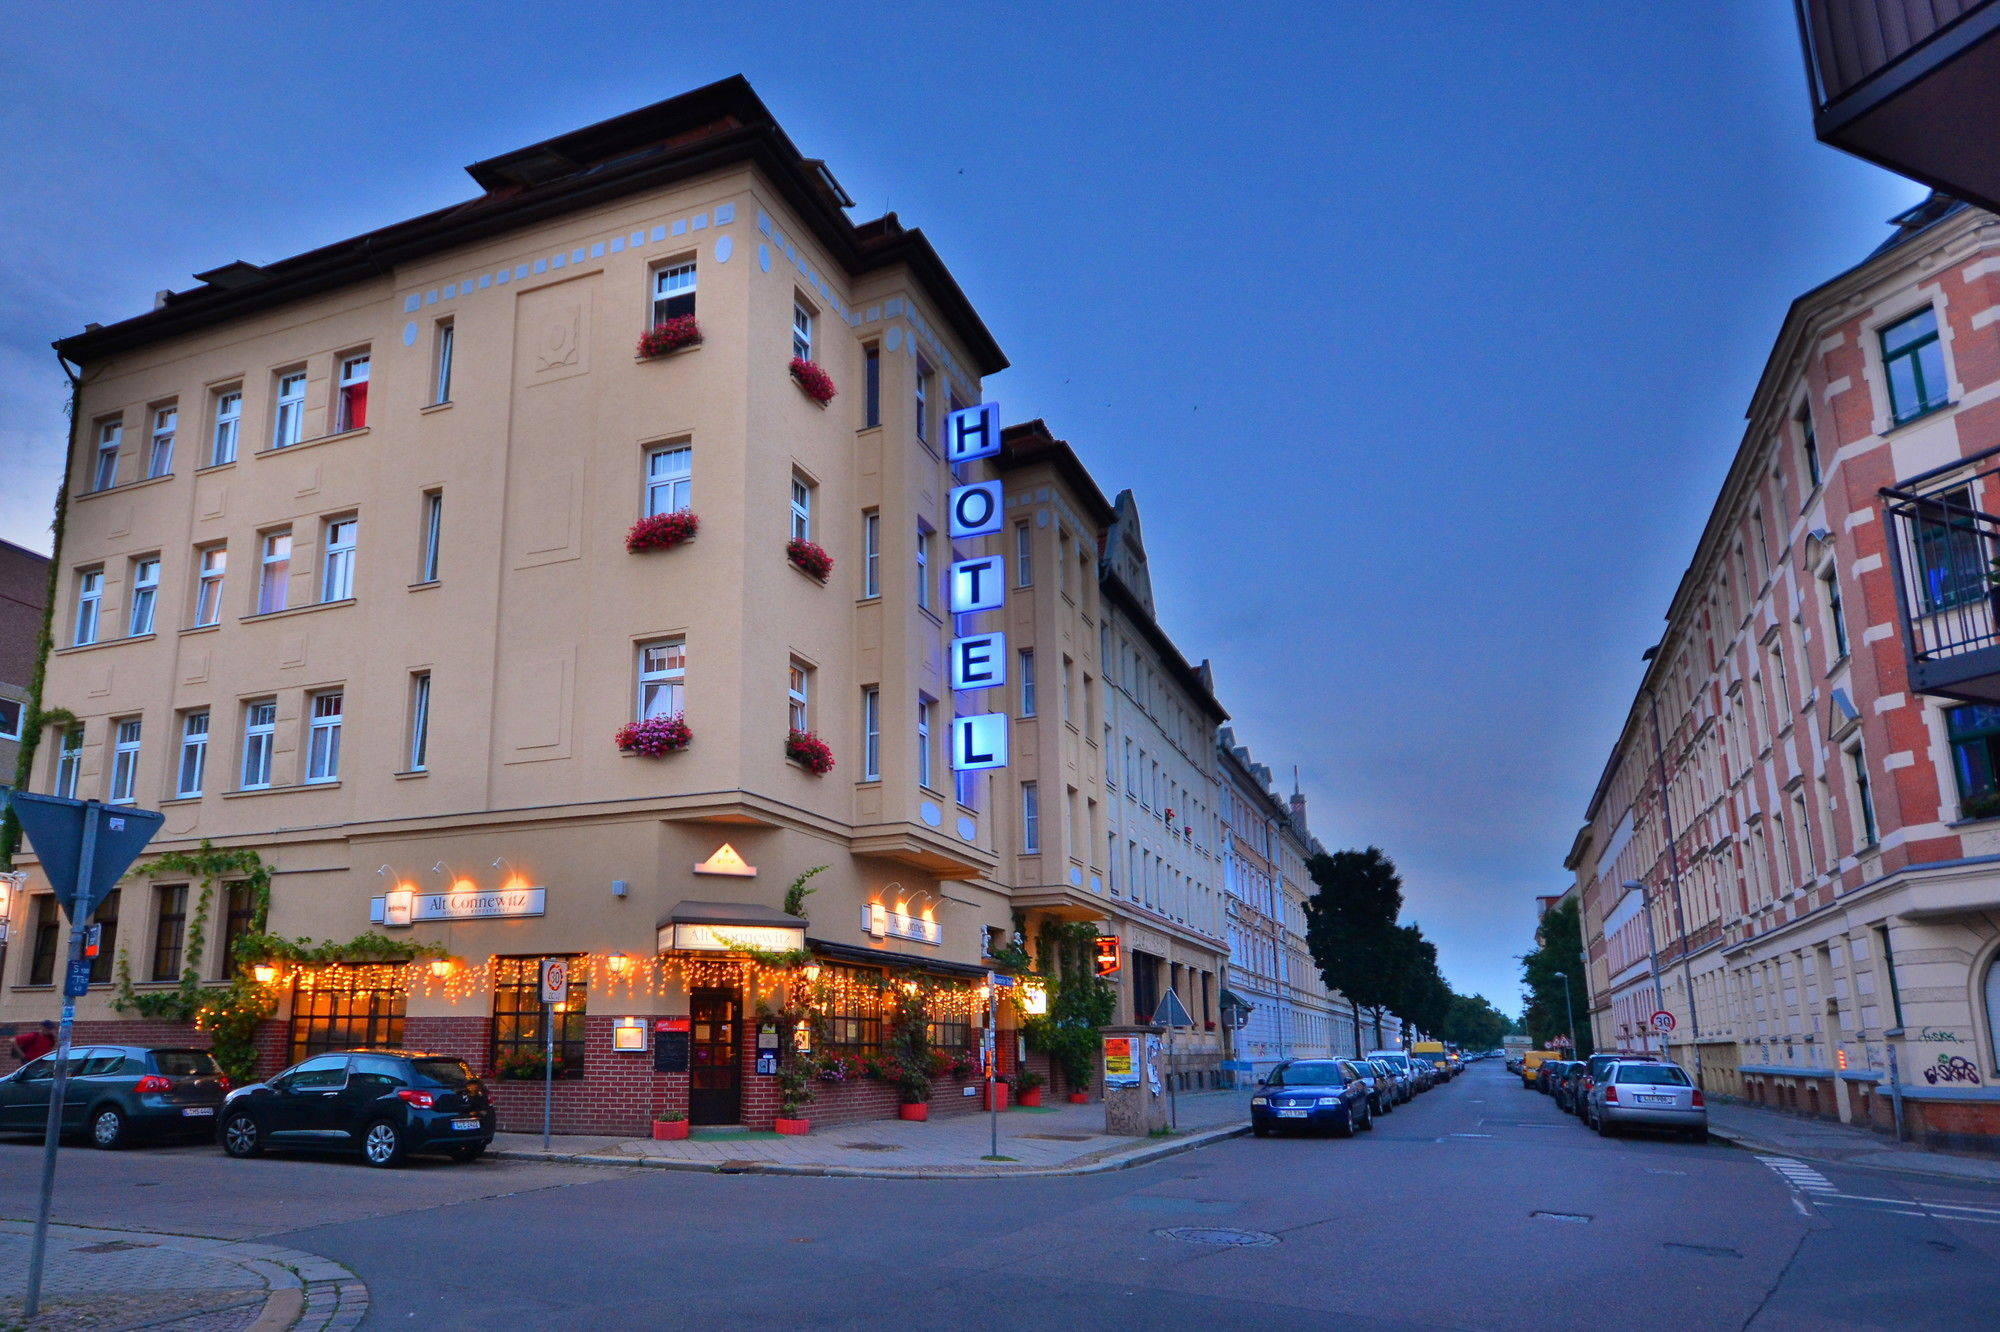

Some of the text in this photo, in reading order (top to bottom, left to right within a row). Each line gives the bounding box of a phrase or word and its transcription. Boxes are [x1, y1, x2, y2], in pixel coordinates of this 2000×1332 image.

[955, 407, 994, 765] HOTEL
[430, 895, 526, 911] Alt Connewitz
[689, 927, 708, 942] Alt
[550, 971, 560, 984] 30
[1655, 1016, 1671, 1027] 30
